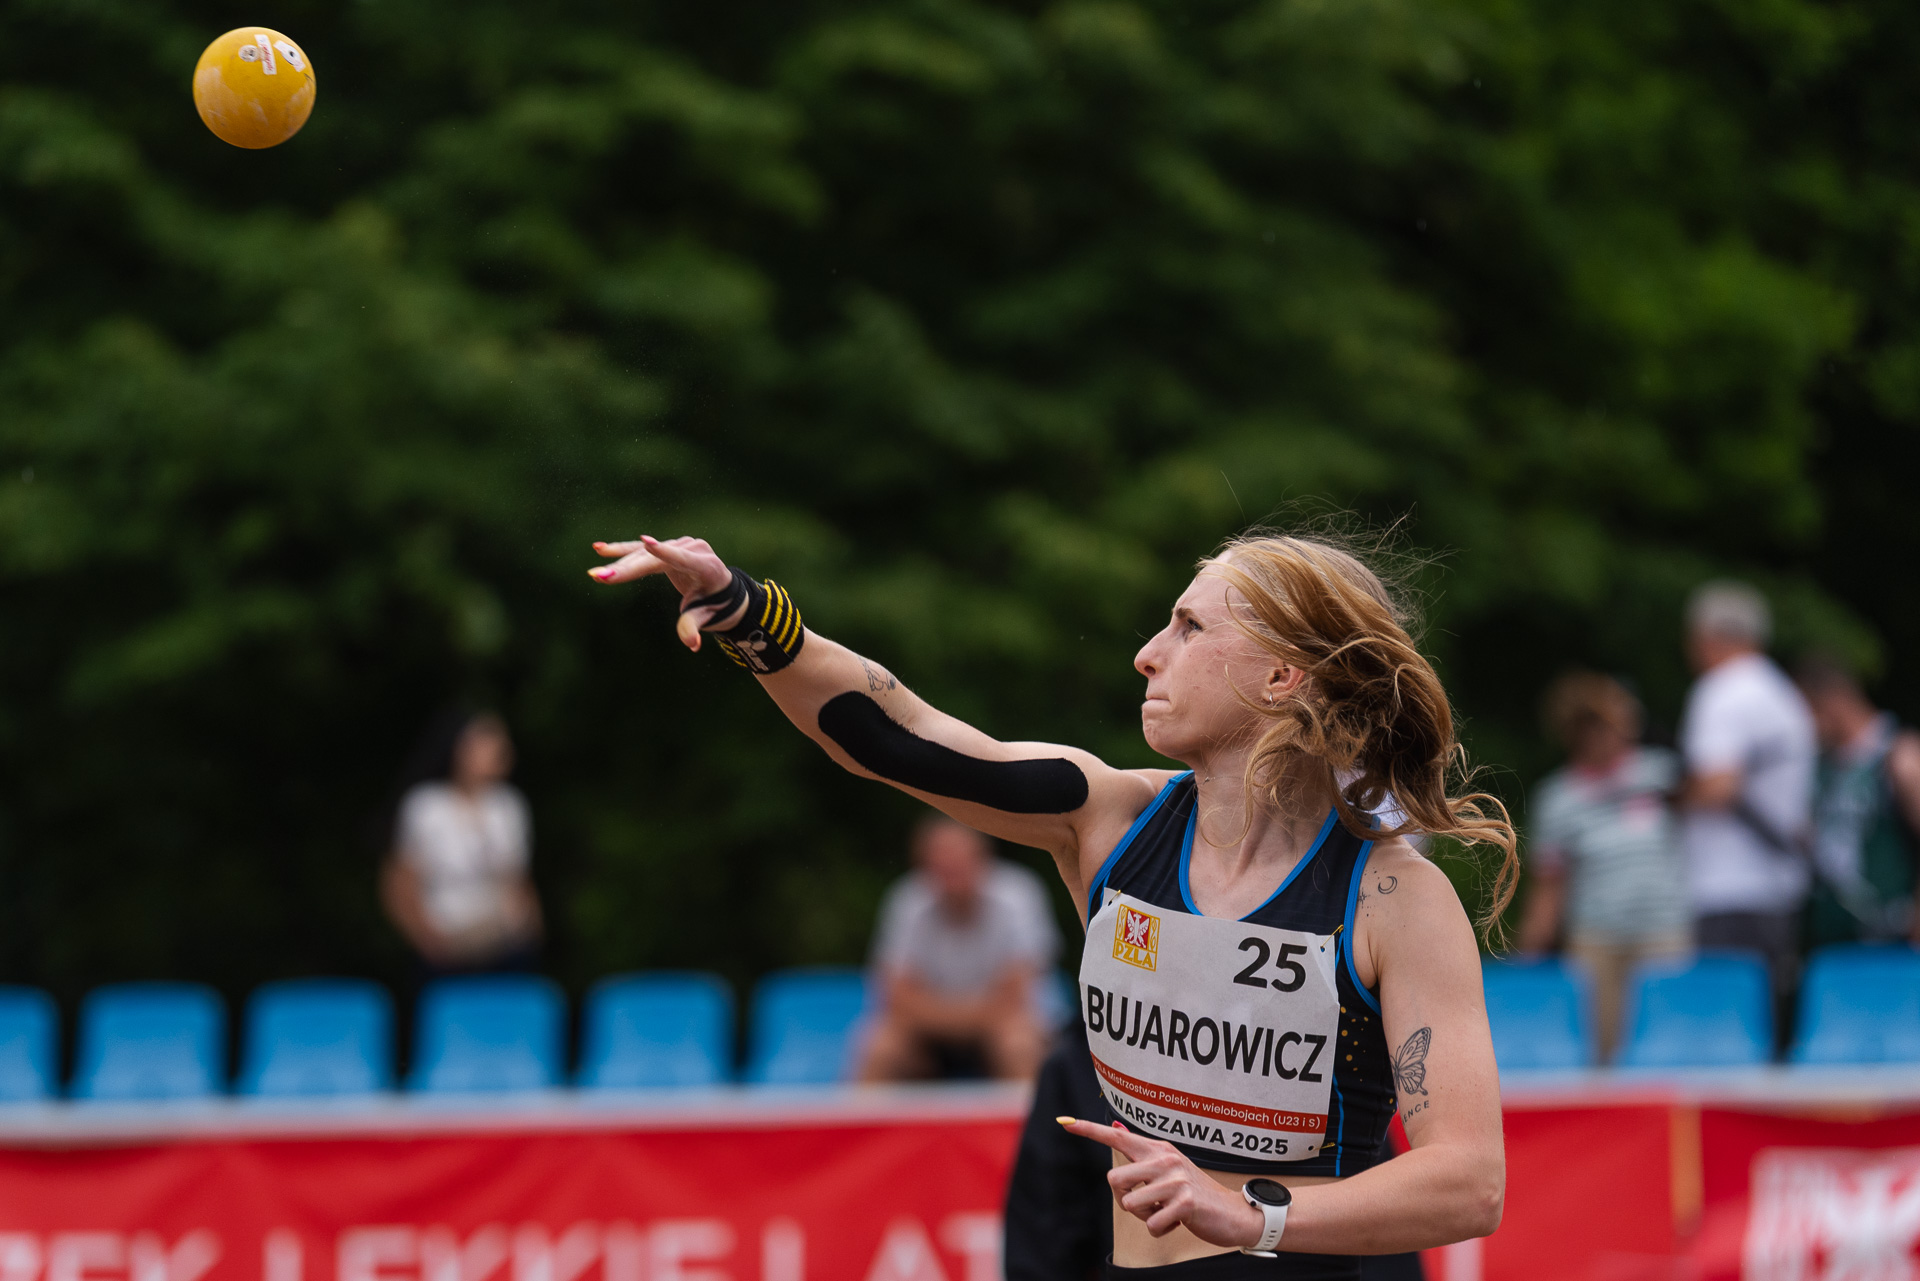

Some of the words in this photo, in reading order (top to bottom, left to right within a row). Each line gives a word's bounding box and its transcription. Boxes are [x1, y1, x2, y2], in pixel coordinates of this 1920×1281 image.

[1114, 940, 1154, 969] PZLA
[1232, 936, 1308, 993] 25
[1086, 984, 1328, 1084] BUJAROWICZ
[1107, 1070, 1157, 1099] Mistrzostwa
[1158, 1091, 1189, 1107] Polski
[1190, 1100, 1200, 1110] w
[1202, 1102, 1270, 1123] wielobojach
[1273, 1112, 1300, 1127] (U23
[1308, 1116, 1321, 1130] S)
[1110, 1090, 1226, 1146] WARSZAWA
[1231, 1131, 1289, 1155] 2025
